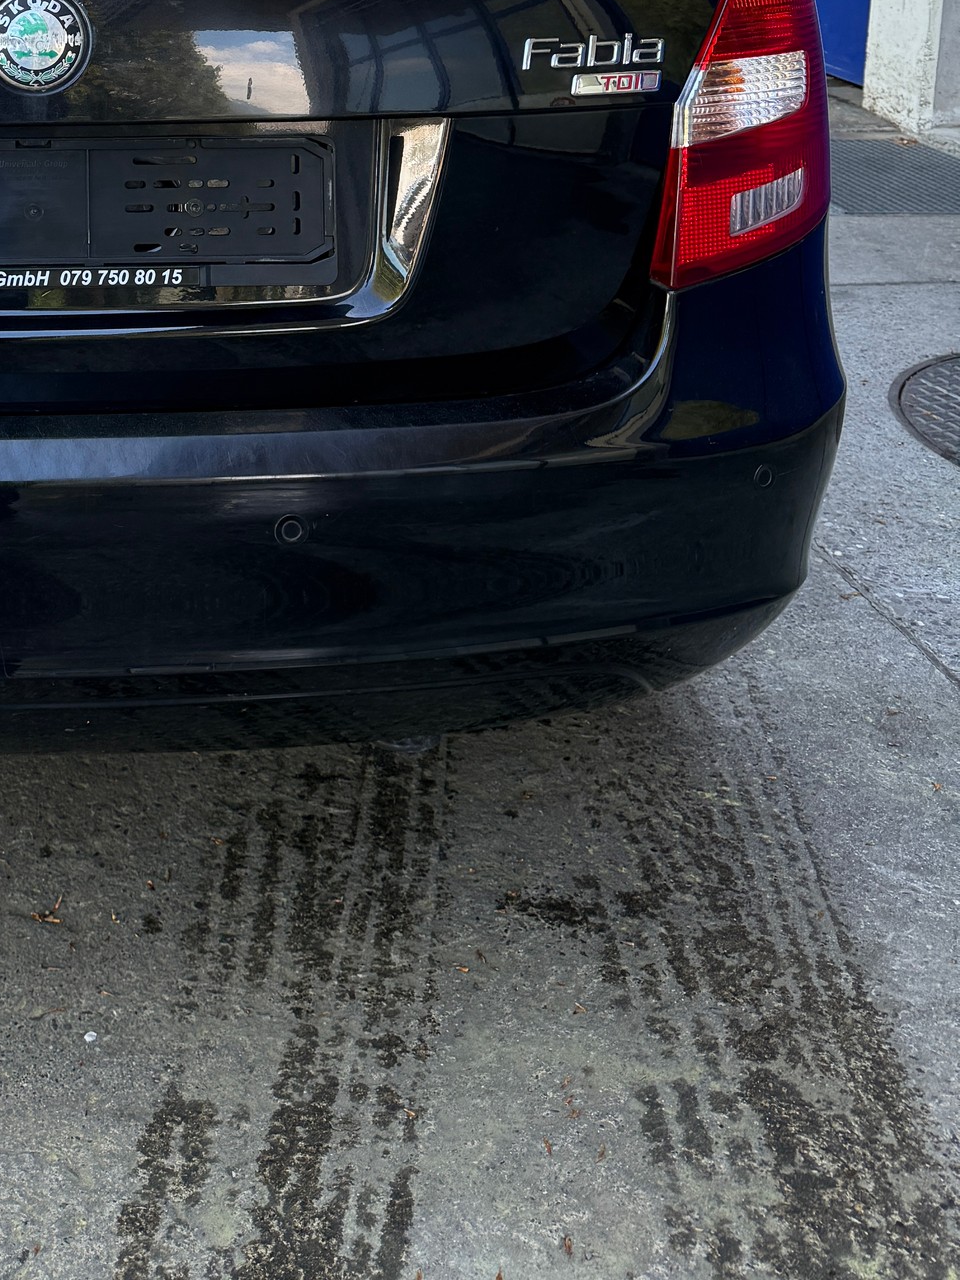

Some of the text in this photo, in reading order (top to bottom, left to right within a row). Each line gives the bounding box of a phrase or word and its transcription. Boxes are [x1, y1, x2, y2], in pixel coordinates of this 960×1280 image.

[522, 33, 665, 70] Fabia
[60, 269, 92, 286] 079
[98, 269, 129, 286] 750
[134, 269, 156, 285] 80
[161, 268, 183, 285] 15
